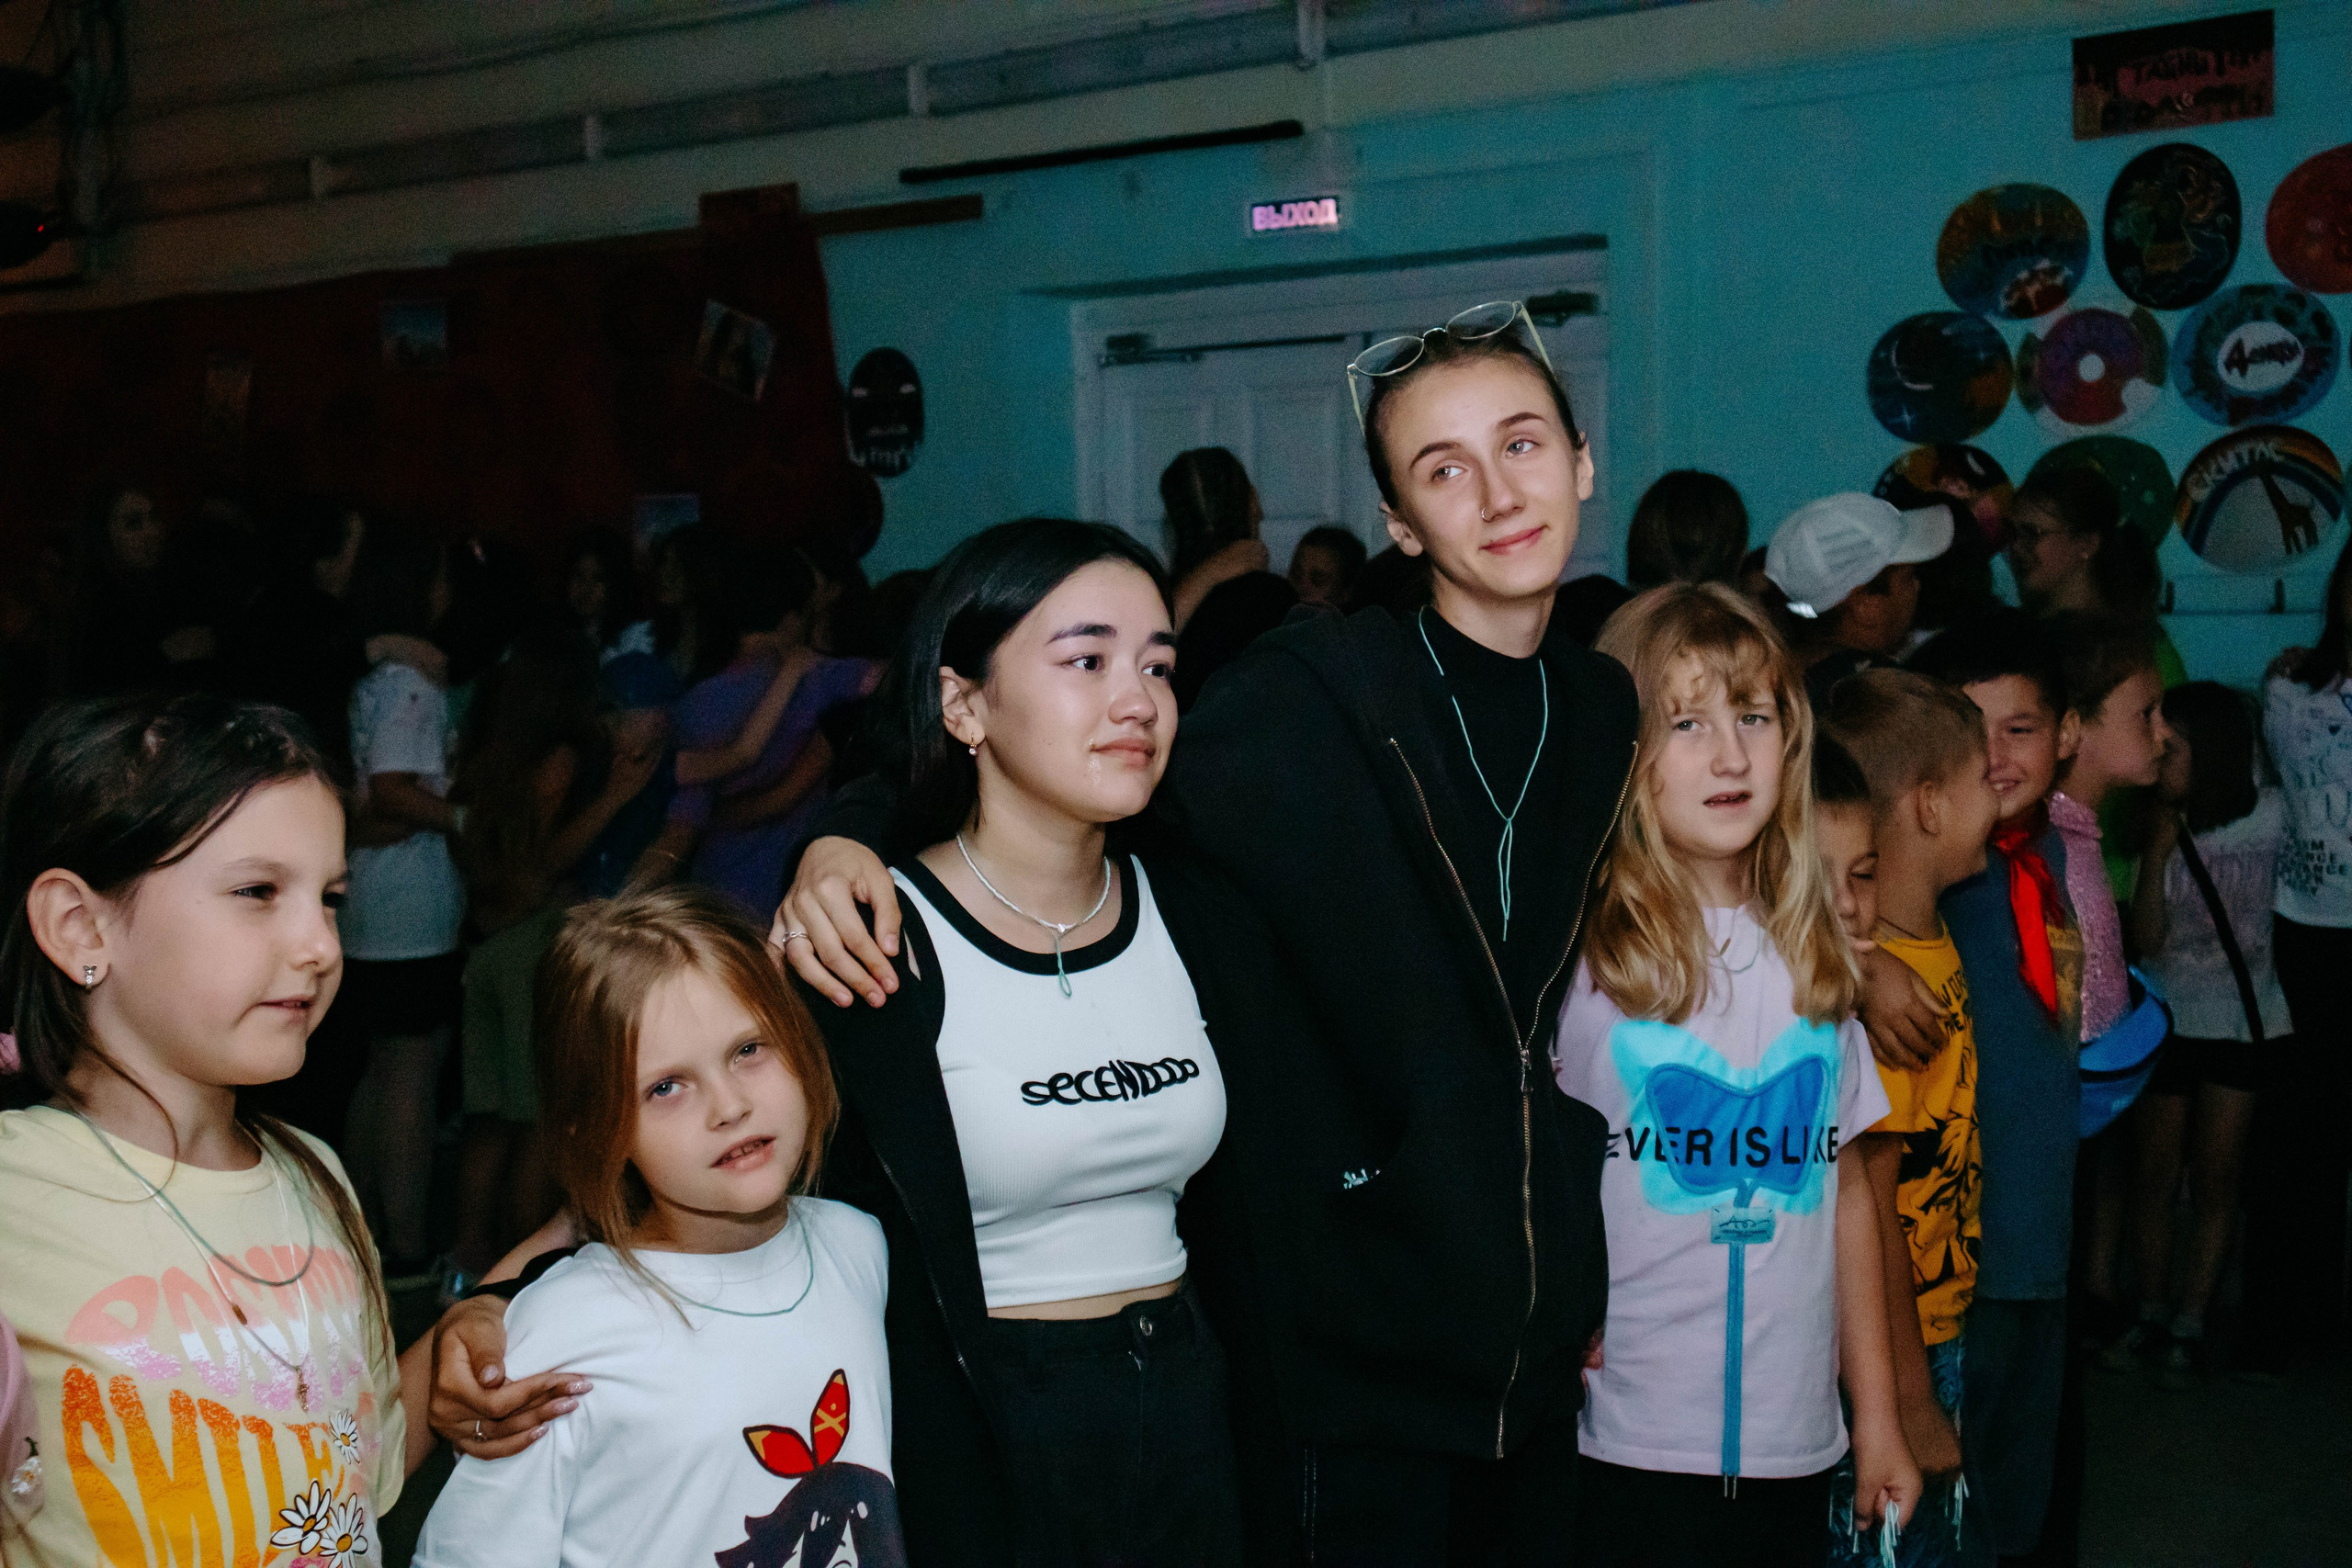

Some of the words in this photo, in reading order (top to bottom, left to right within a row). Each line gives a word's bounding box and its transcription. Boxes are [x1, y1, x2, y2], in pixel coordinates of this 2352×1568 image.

[1252, 197, 1339, 231] ВЫХОД
[1729, 1126, 1771, 1168] IS
[1782, 1125, 1838, 1164] LIKE
